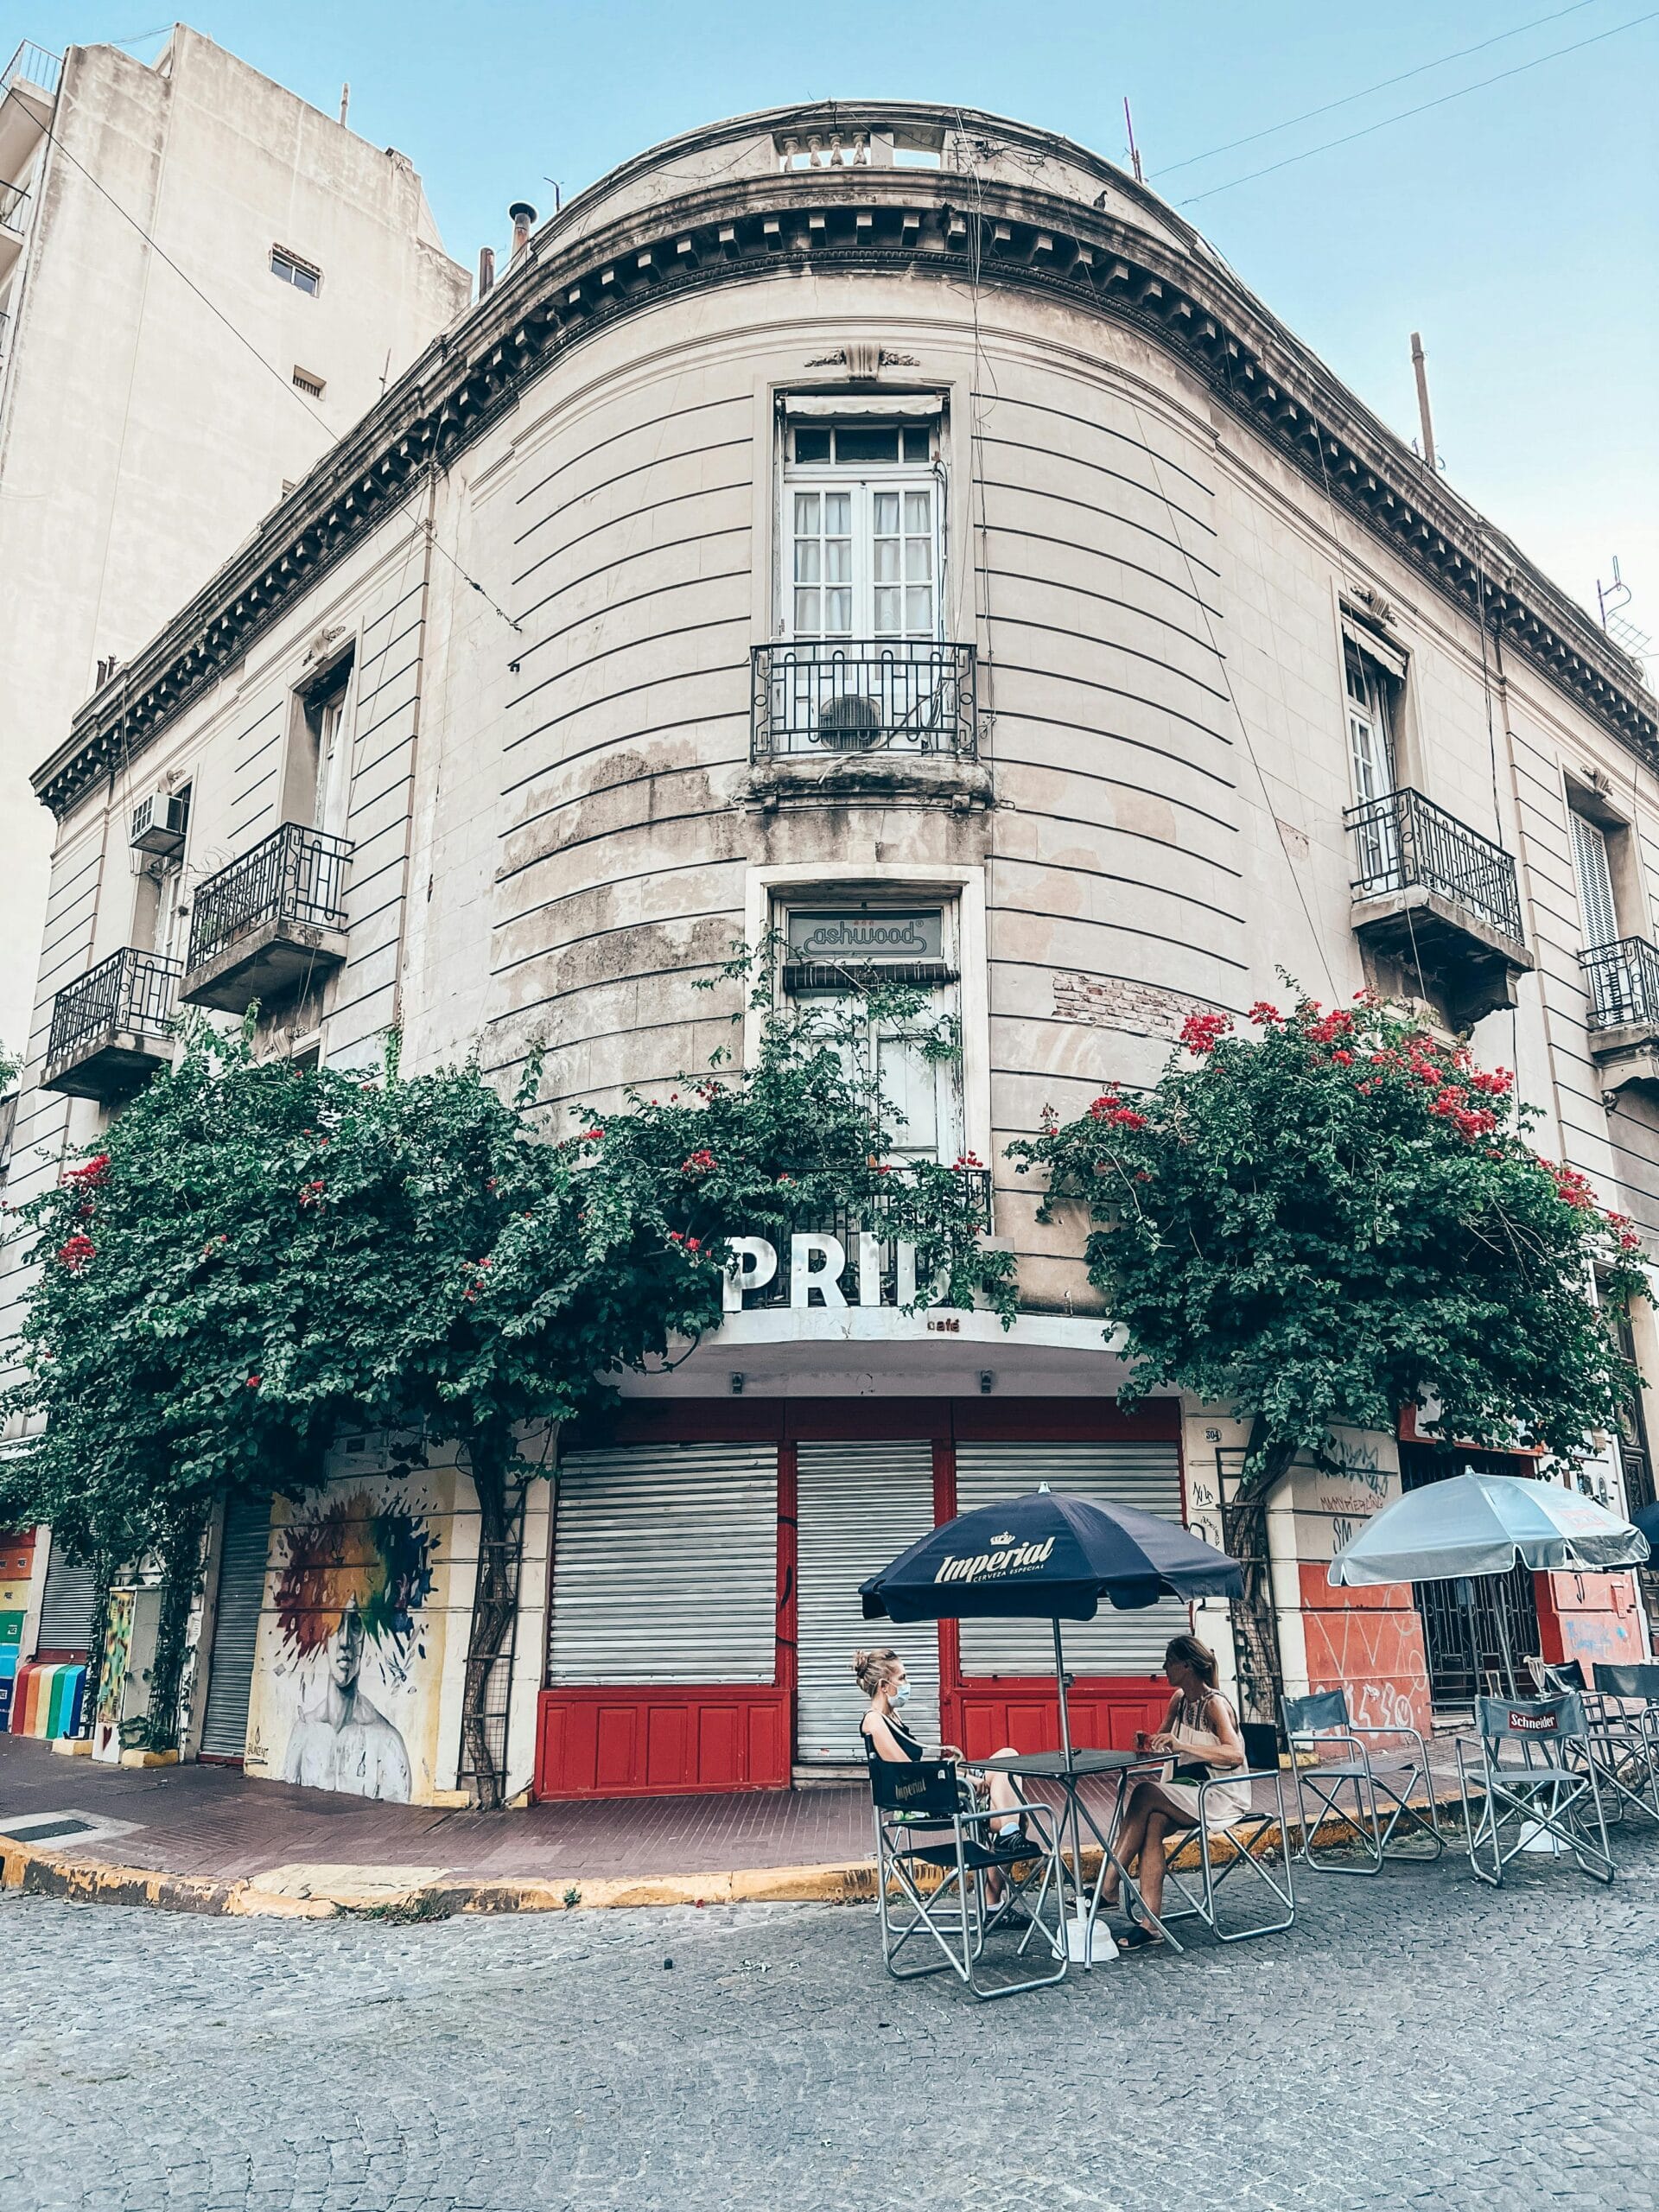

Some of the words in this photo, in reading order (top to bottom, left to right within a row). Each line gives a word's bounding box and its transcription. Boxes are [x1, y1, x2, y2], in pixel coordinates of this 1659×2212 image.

[814, 921, 914, 944] ashwood
[927, 1318, 960, 1332] café
[1205, 1430, 1220, 1440] 304
[934, 1536, 1056, 1584] Imperial
[973, 1571, 1007, 1583] CERVEZA
[1009, 1563, 1045, 1575] ESPECIAL
[1510, 1713, 1555, 1729] Schneider
[895, 1777, 926, 1801] Imperial
